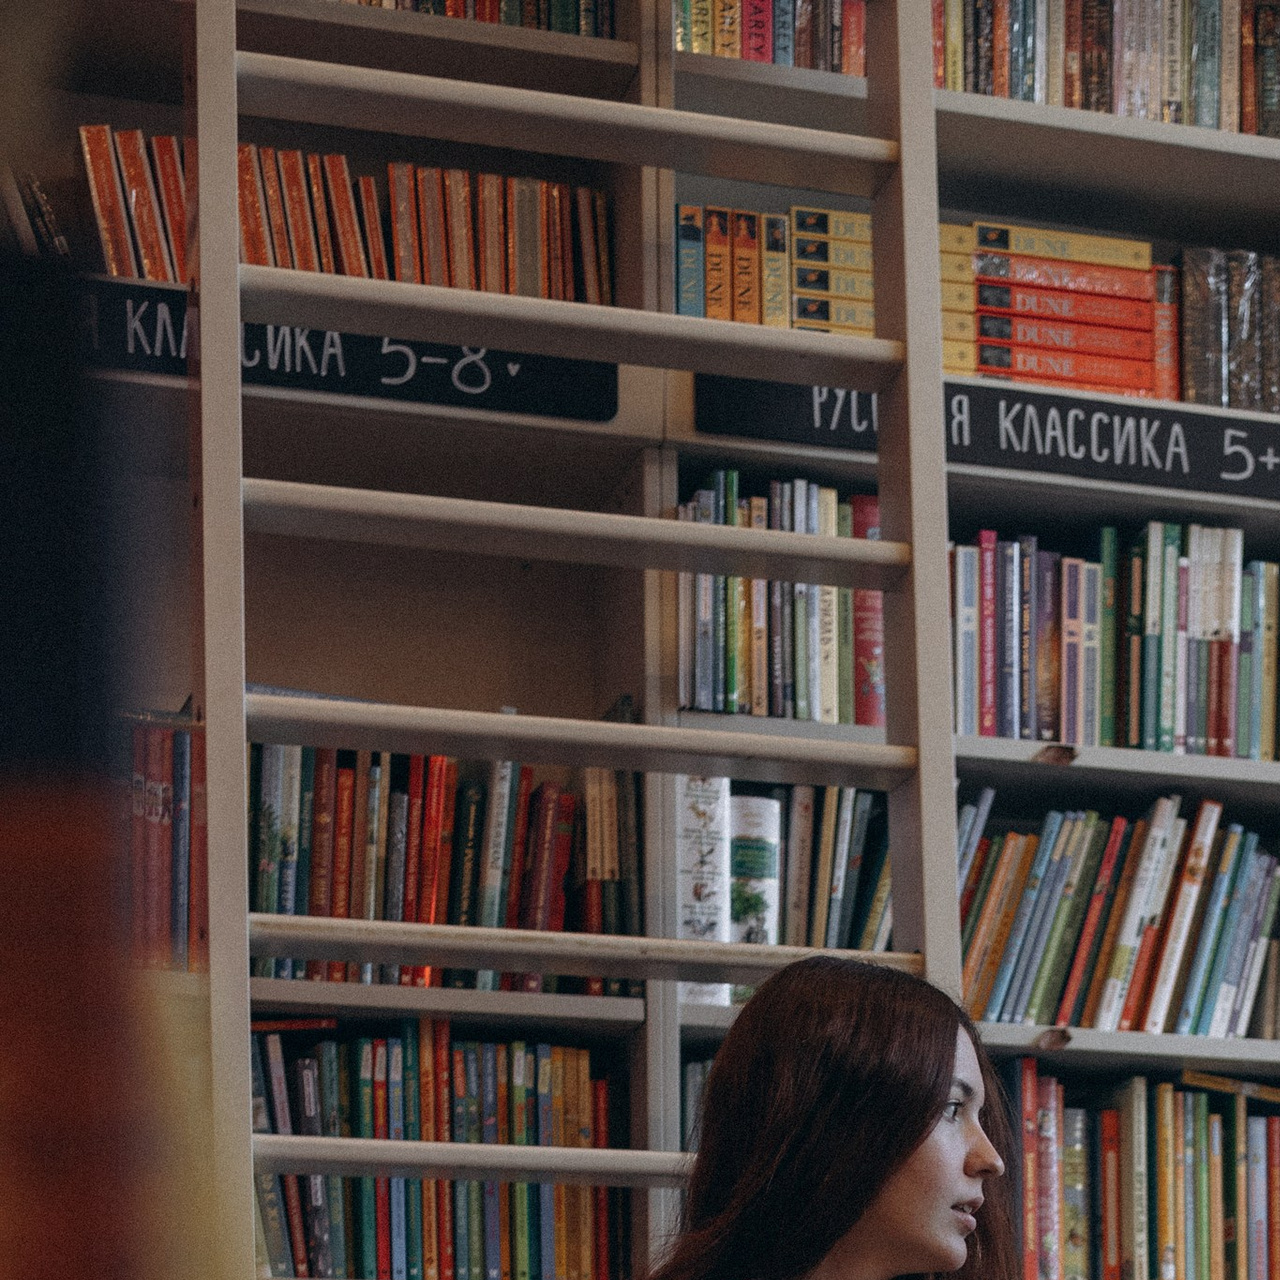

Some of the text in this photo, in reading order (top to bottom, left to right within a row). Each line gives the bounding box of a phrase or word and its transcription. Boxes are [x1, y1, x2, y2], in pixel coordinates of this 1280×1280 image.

[749, 0, 766, 56] AREY
[776, 0, 791, 54] AREY
[708, 252, 723, 308] DUNE
[737, 255, 752, 311] DUNE
[1016, 293, 1076, 317] DUNE
[125, 299, 346, 378] КЛСИКА
[380, 336, 493, 395] 5-8
[1016, 323, 1077, 347] DUNE
[1016, 352, 1077, 377] DUNE
[998, 400, 1190, 474] КЛАССИКА
